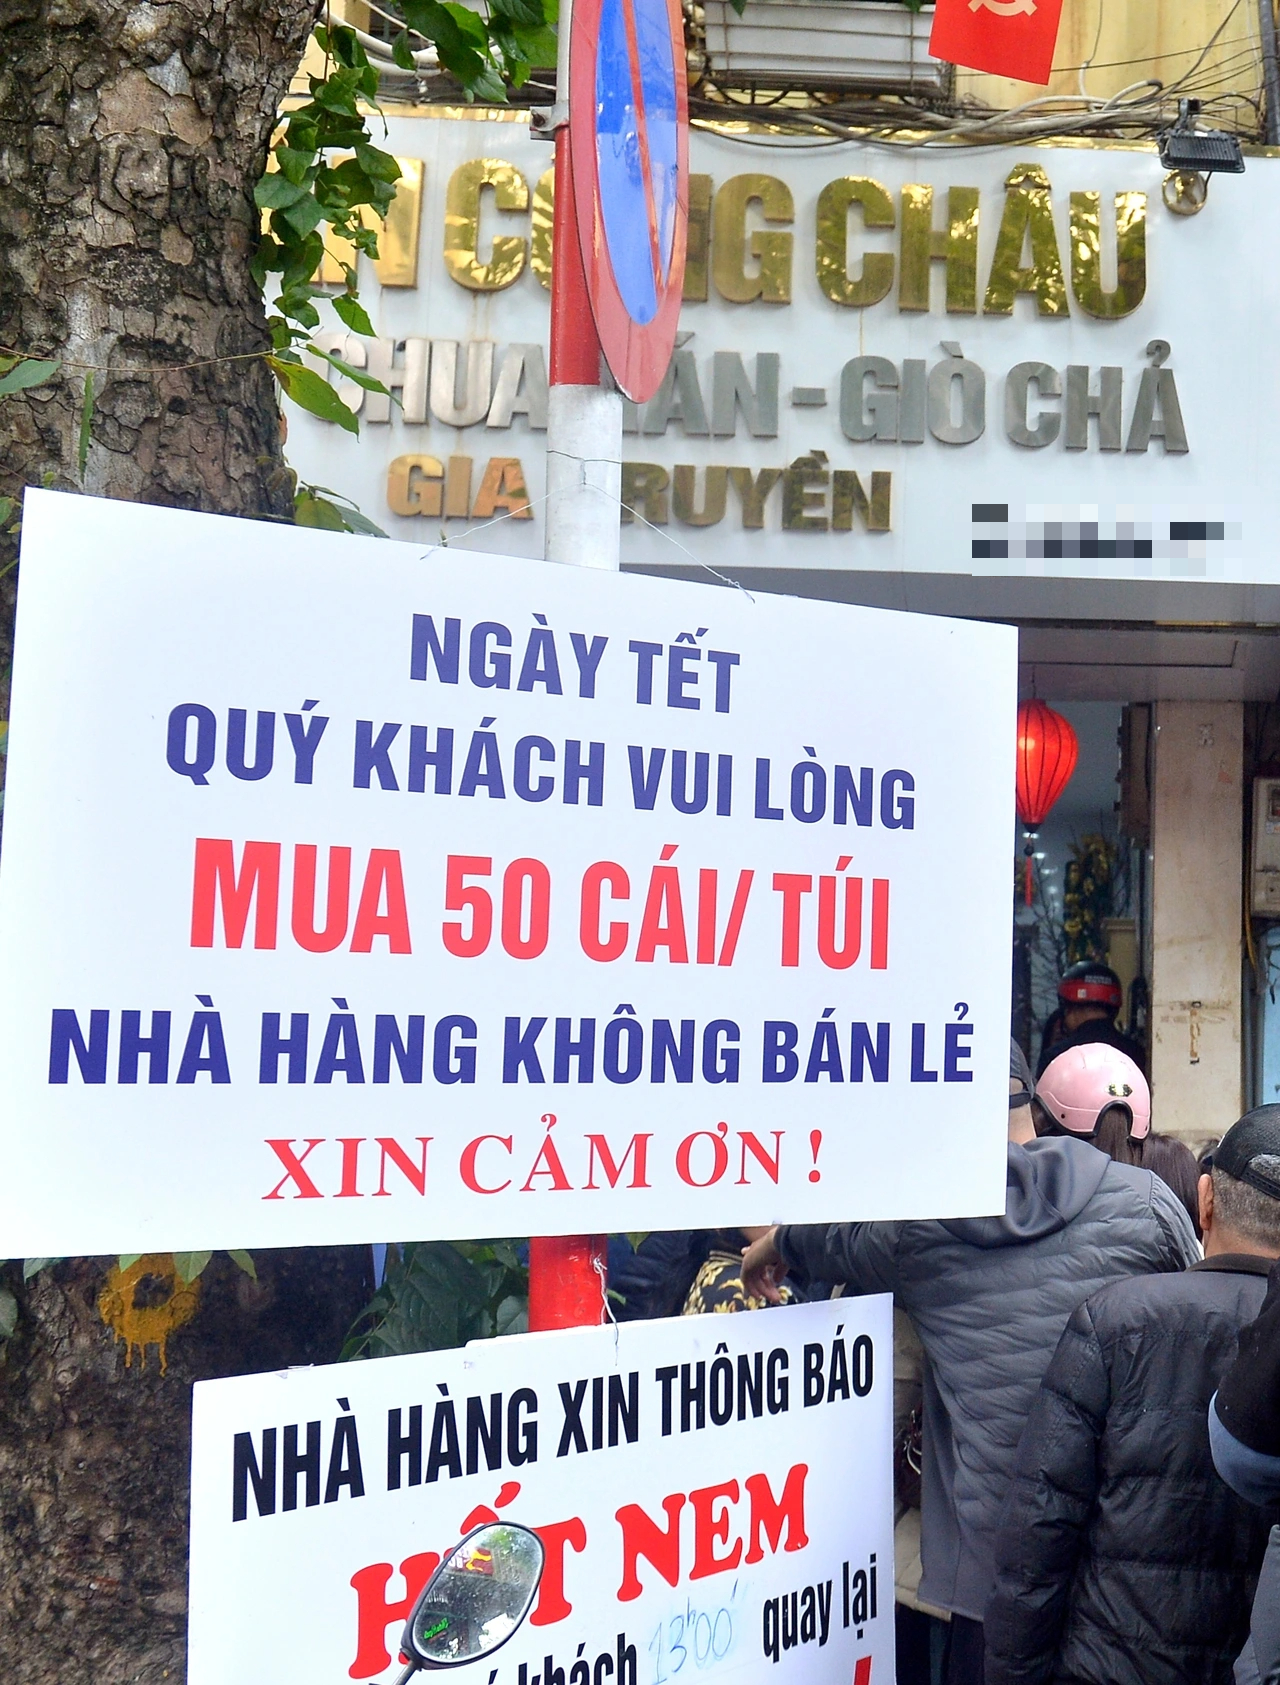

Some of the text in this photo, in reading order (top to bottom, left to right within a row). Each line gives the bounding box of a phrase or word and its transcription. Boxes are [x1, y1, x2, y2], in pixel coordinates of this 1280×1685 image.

[816, 162, 1149, 320] CHÂU
[1004, 339, 1190, 454] CHẢ
[387, 449, 892, 532] GIA RUYỀN
[410, 612, 741, 714] NGÀY TẾT
[166, 699, 916, 830] QUÝ KHÁCH VUI LÒNG
[190, 837, 412, 954] MUA
[442, 854, 550, 961] 50
[772, 855, 890, 970] TÚI
[48, 994, 975, 1085] NHÀ HÀNG KHÔNG BÁN LẺ
[261, 1136, 434, 1200] XIN
[459, 1113, 654, 1195] CẢM
[675, 1121, 786, 1188] ƠN
[232, 1324, 874, 1523] NHÀ HÀNG XIN THÔNG BÁO
[349, 1463, 810, 1680] HT NEM
[763, 1579, 833, 1664] quay
[842, 1552, 877, 1641] lại
